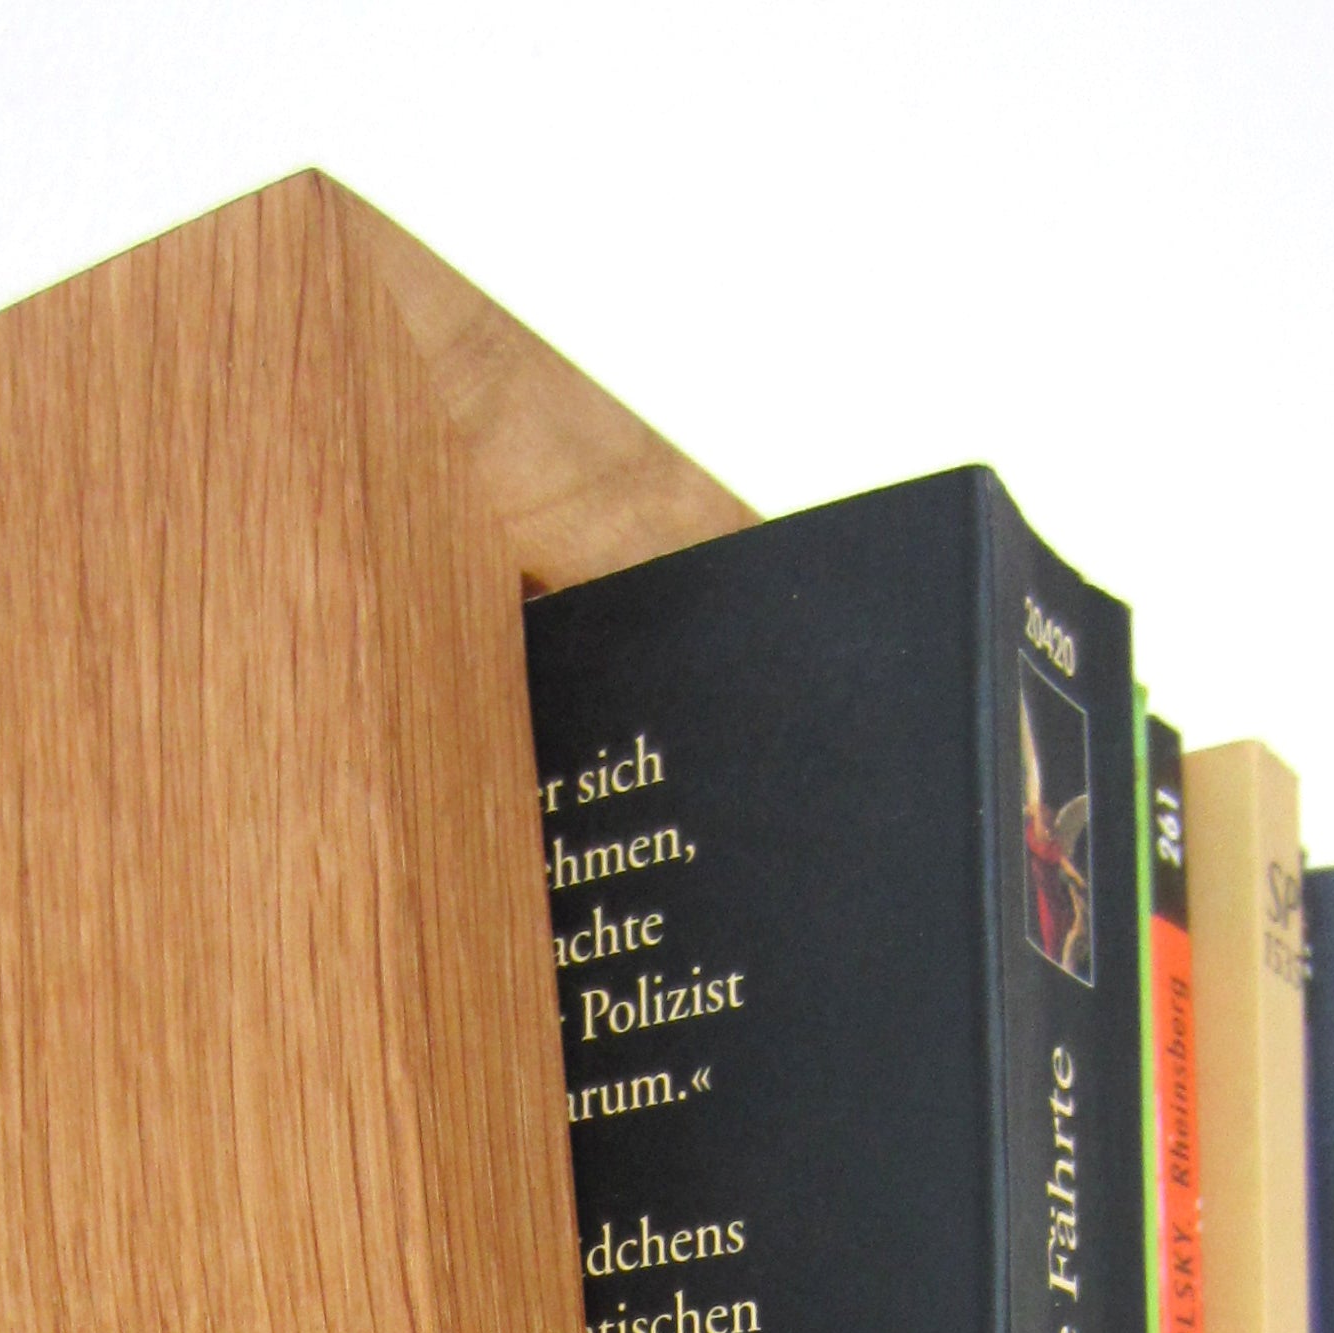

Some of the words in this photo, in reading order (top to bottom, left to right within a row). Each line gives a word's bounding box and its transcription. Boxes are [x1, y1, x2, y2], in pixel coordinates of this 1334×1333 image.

[1024, 595, 1076, 677] 20420
[577, 734, 665, 804] sich
[546, 828, 697, 890] hmen,
[580, 965, 746, 1041] Polizist
[1165, 974, 1192, 1189] Rheinsberg
[1045, 1045, 1080, 1307] Fährte
[581, 1215, 746, 1278] dchens
